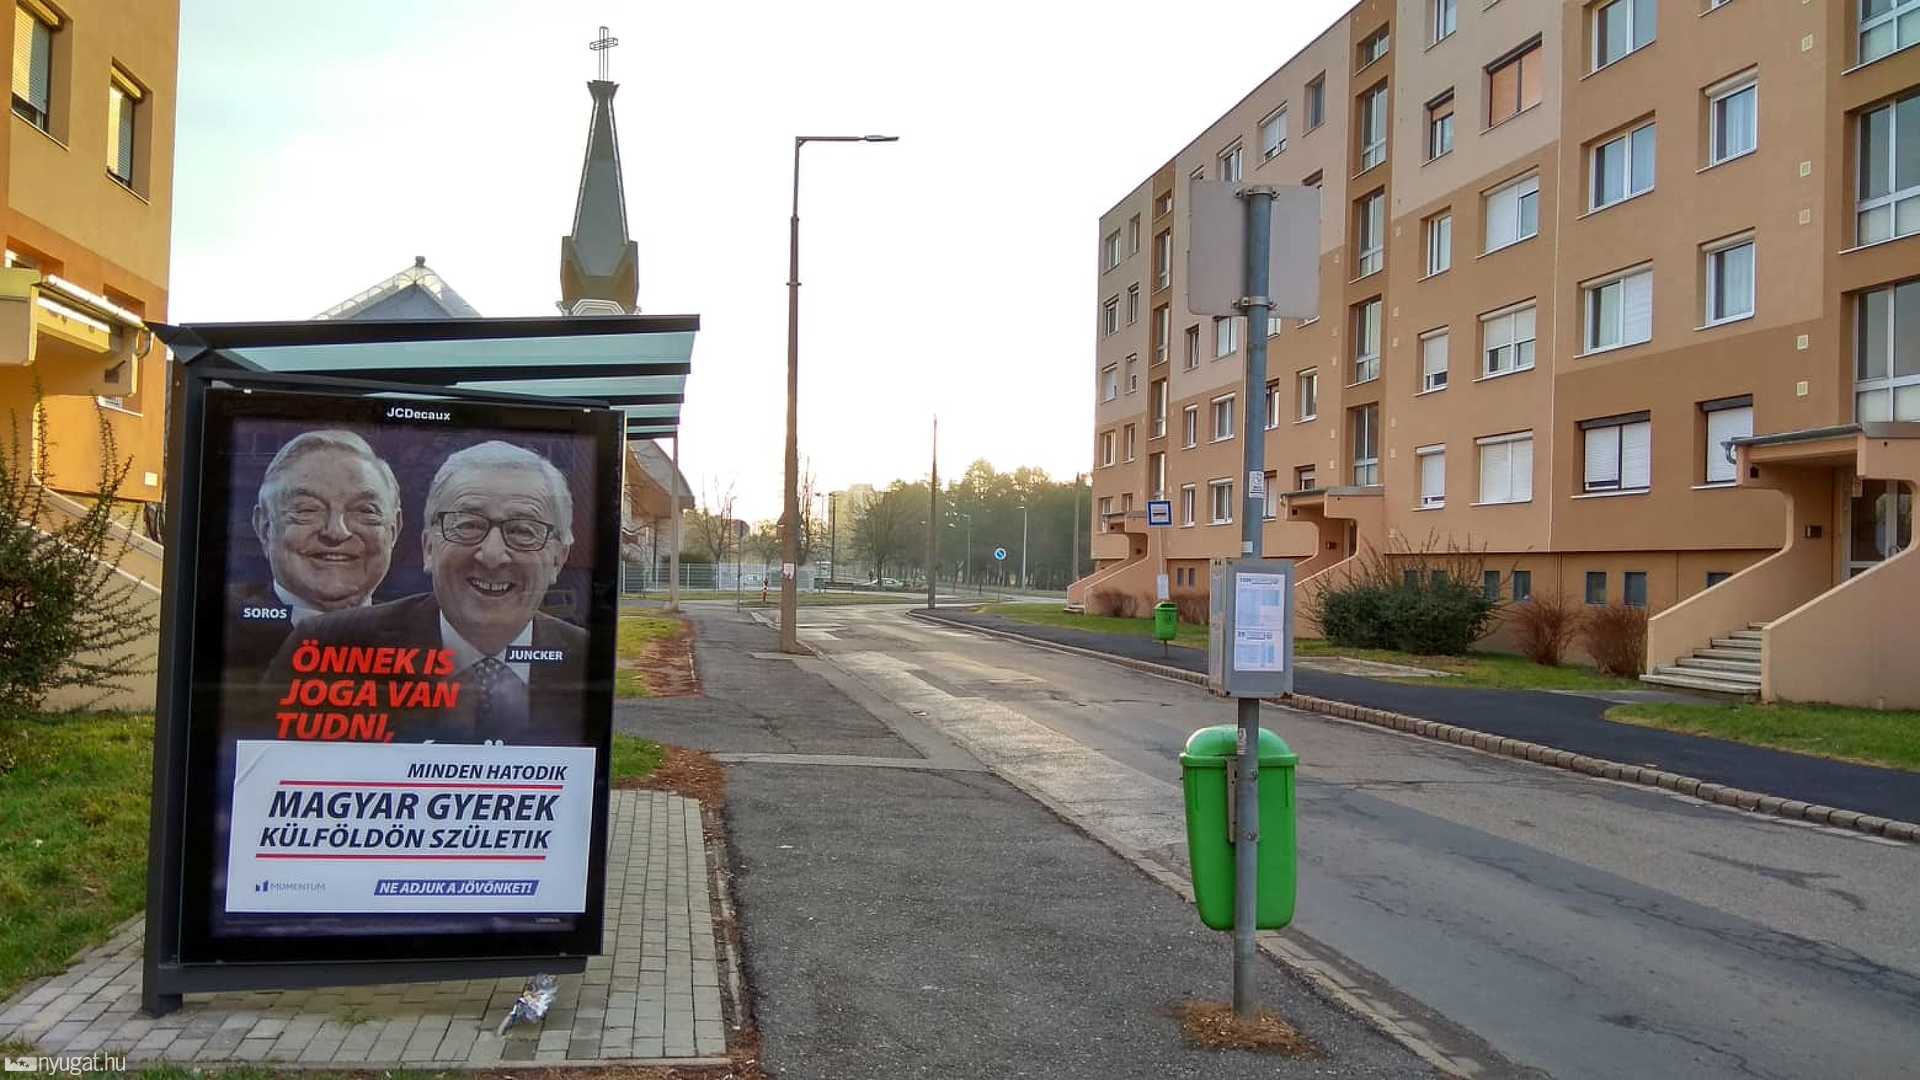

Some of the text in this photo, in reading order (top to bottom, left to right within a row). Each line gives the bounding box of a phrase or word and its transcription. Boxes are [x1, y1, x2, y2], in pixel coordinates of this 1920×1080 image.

[386, 407, 451, 421] JCDecaux
[243, 607, 288, 620] SOROS
[292, 639, 456, 675] ÖNNEK IS
[508, 649, 564, 662] JUNCKER
[280, 679, 462, 709] JOGA VAN
[275, 712, 395, 742] TUDNI,
[407, 762, 568, 781] MINDEN HATODIK
[268, 790, 560, 822] MAGYAR GYEREK
[260, 823, 552, 850] KÜLFÖLDÖN SZÜLETIK
[270, 881, 326, 892] MOMENTUM
[379, 882, 399, 894] NE
[400, 882, 446, 894] ADJUK
[446, 882, 456, 894] A
